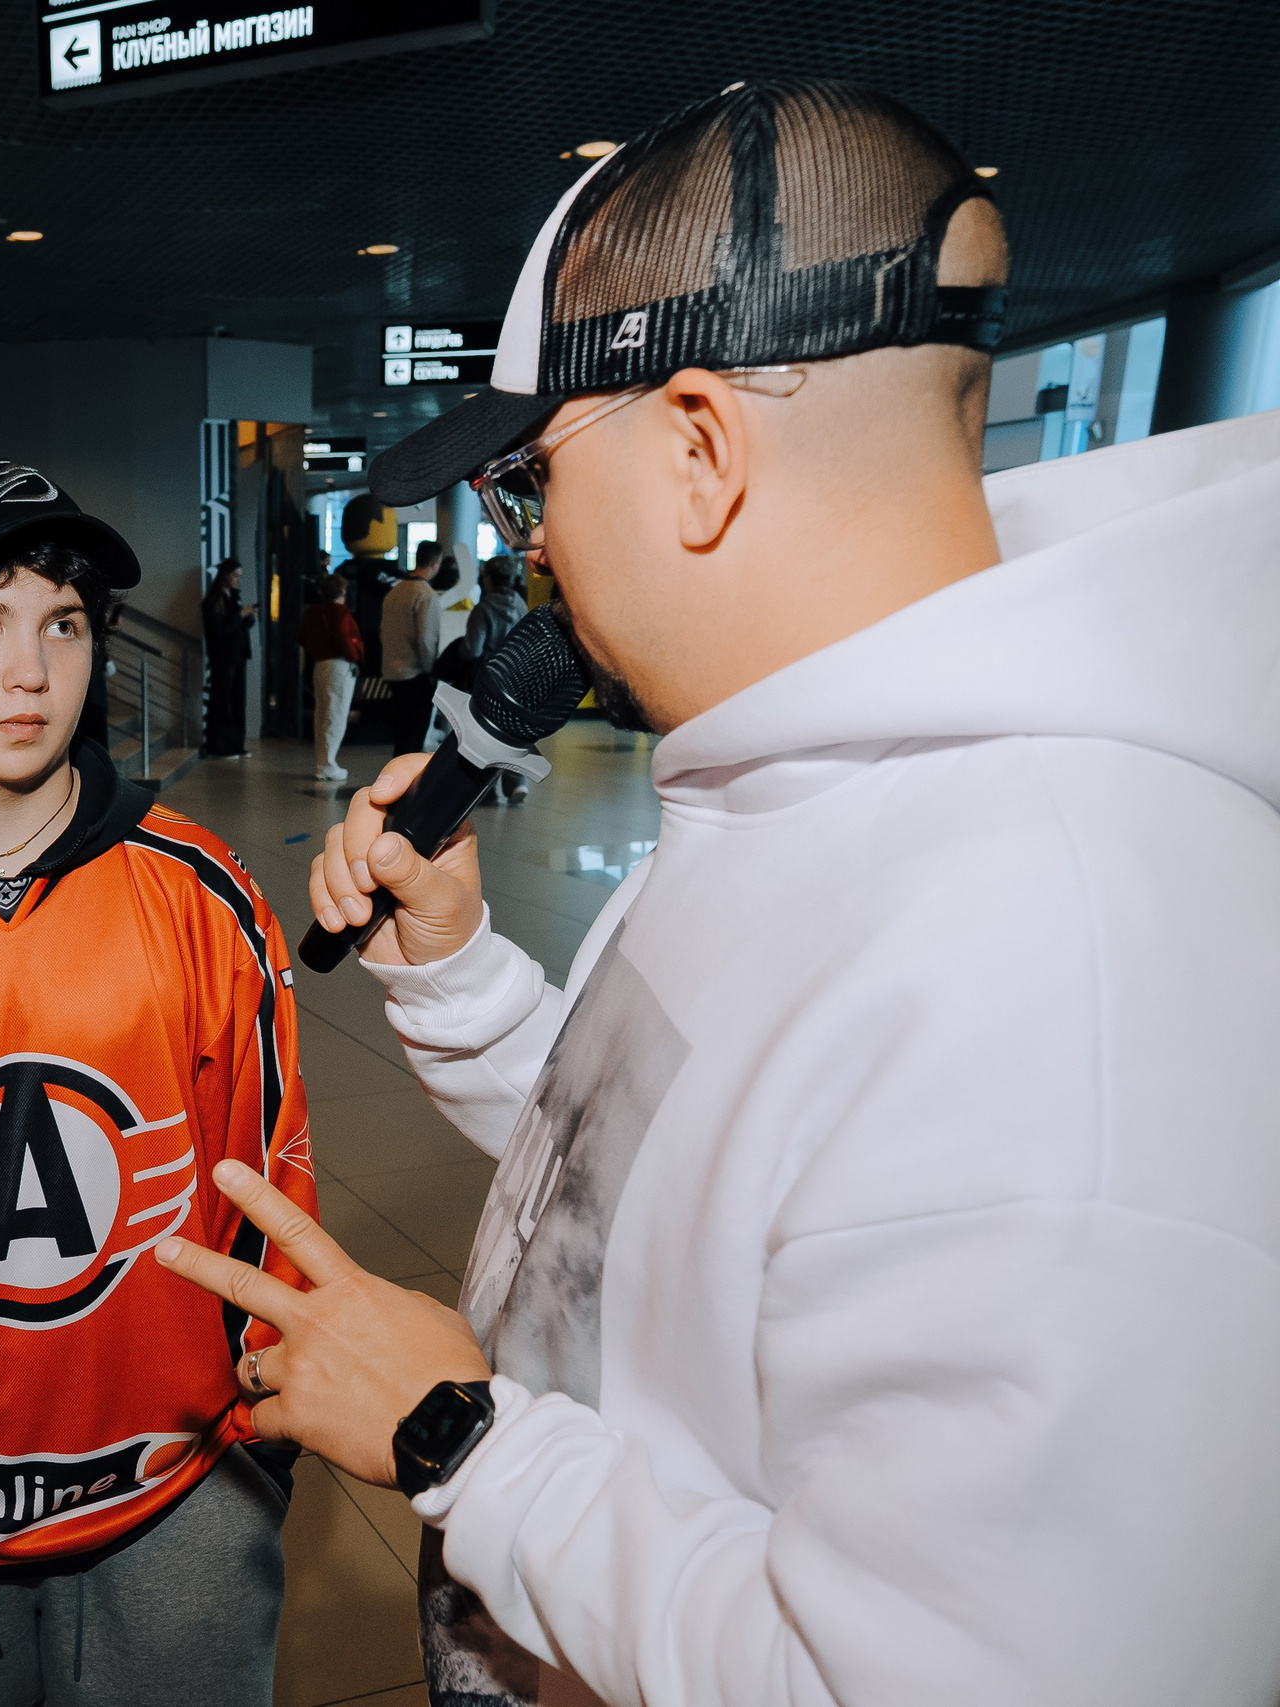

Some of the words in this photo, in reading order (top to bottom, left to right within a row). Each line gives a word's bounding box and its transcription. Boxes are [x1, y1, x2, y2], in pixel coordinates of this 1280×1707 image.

[112, 22, 137, 41] FAN
[138, 17, 171, 37] SHOP
[112, 19, 210, 71] КЛУБНЫЙ
[214, 6, 314, 52] МАГАЗИН
